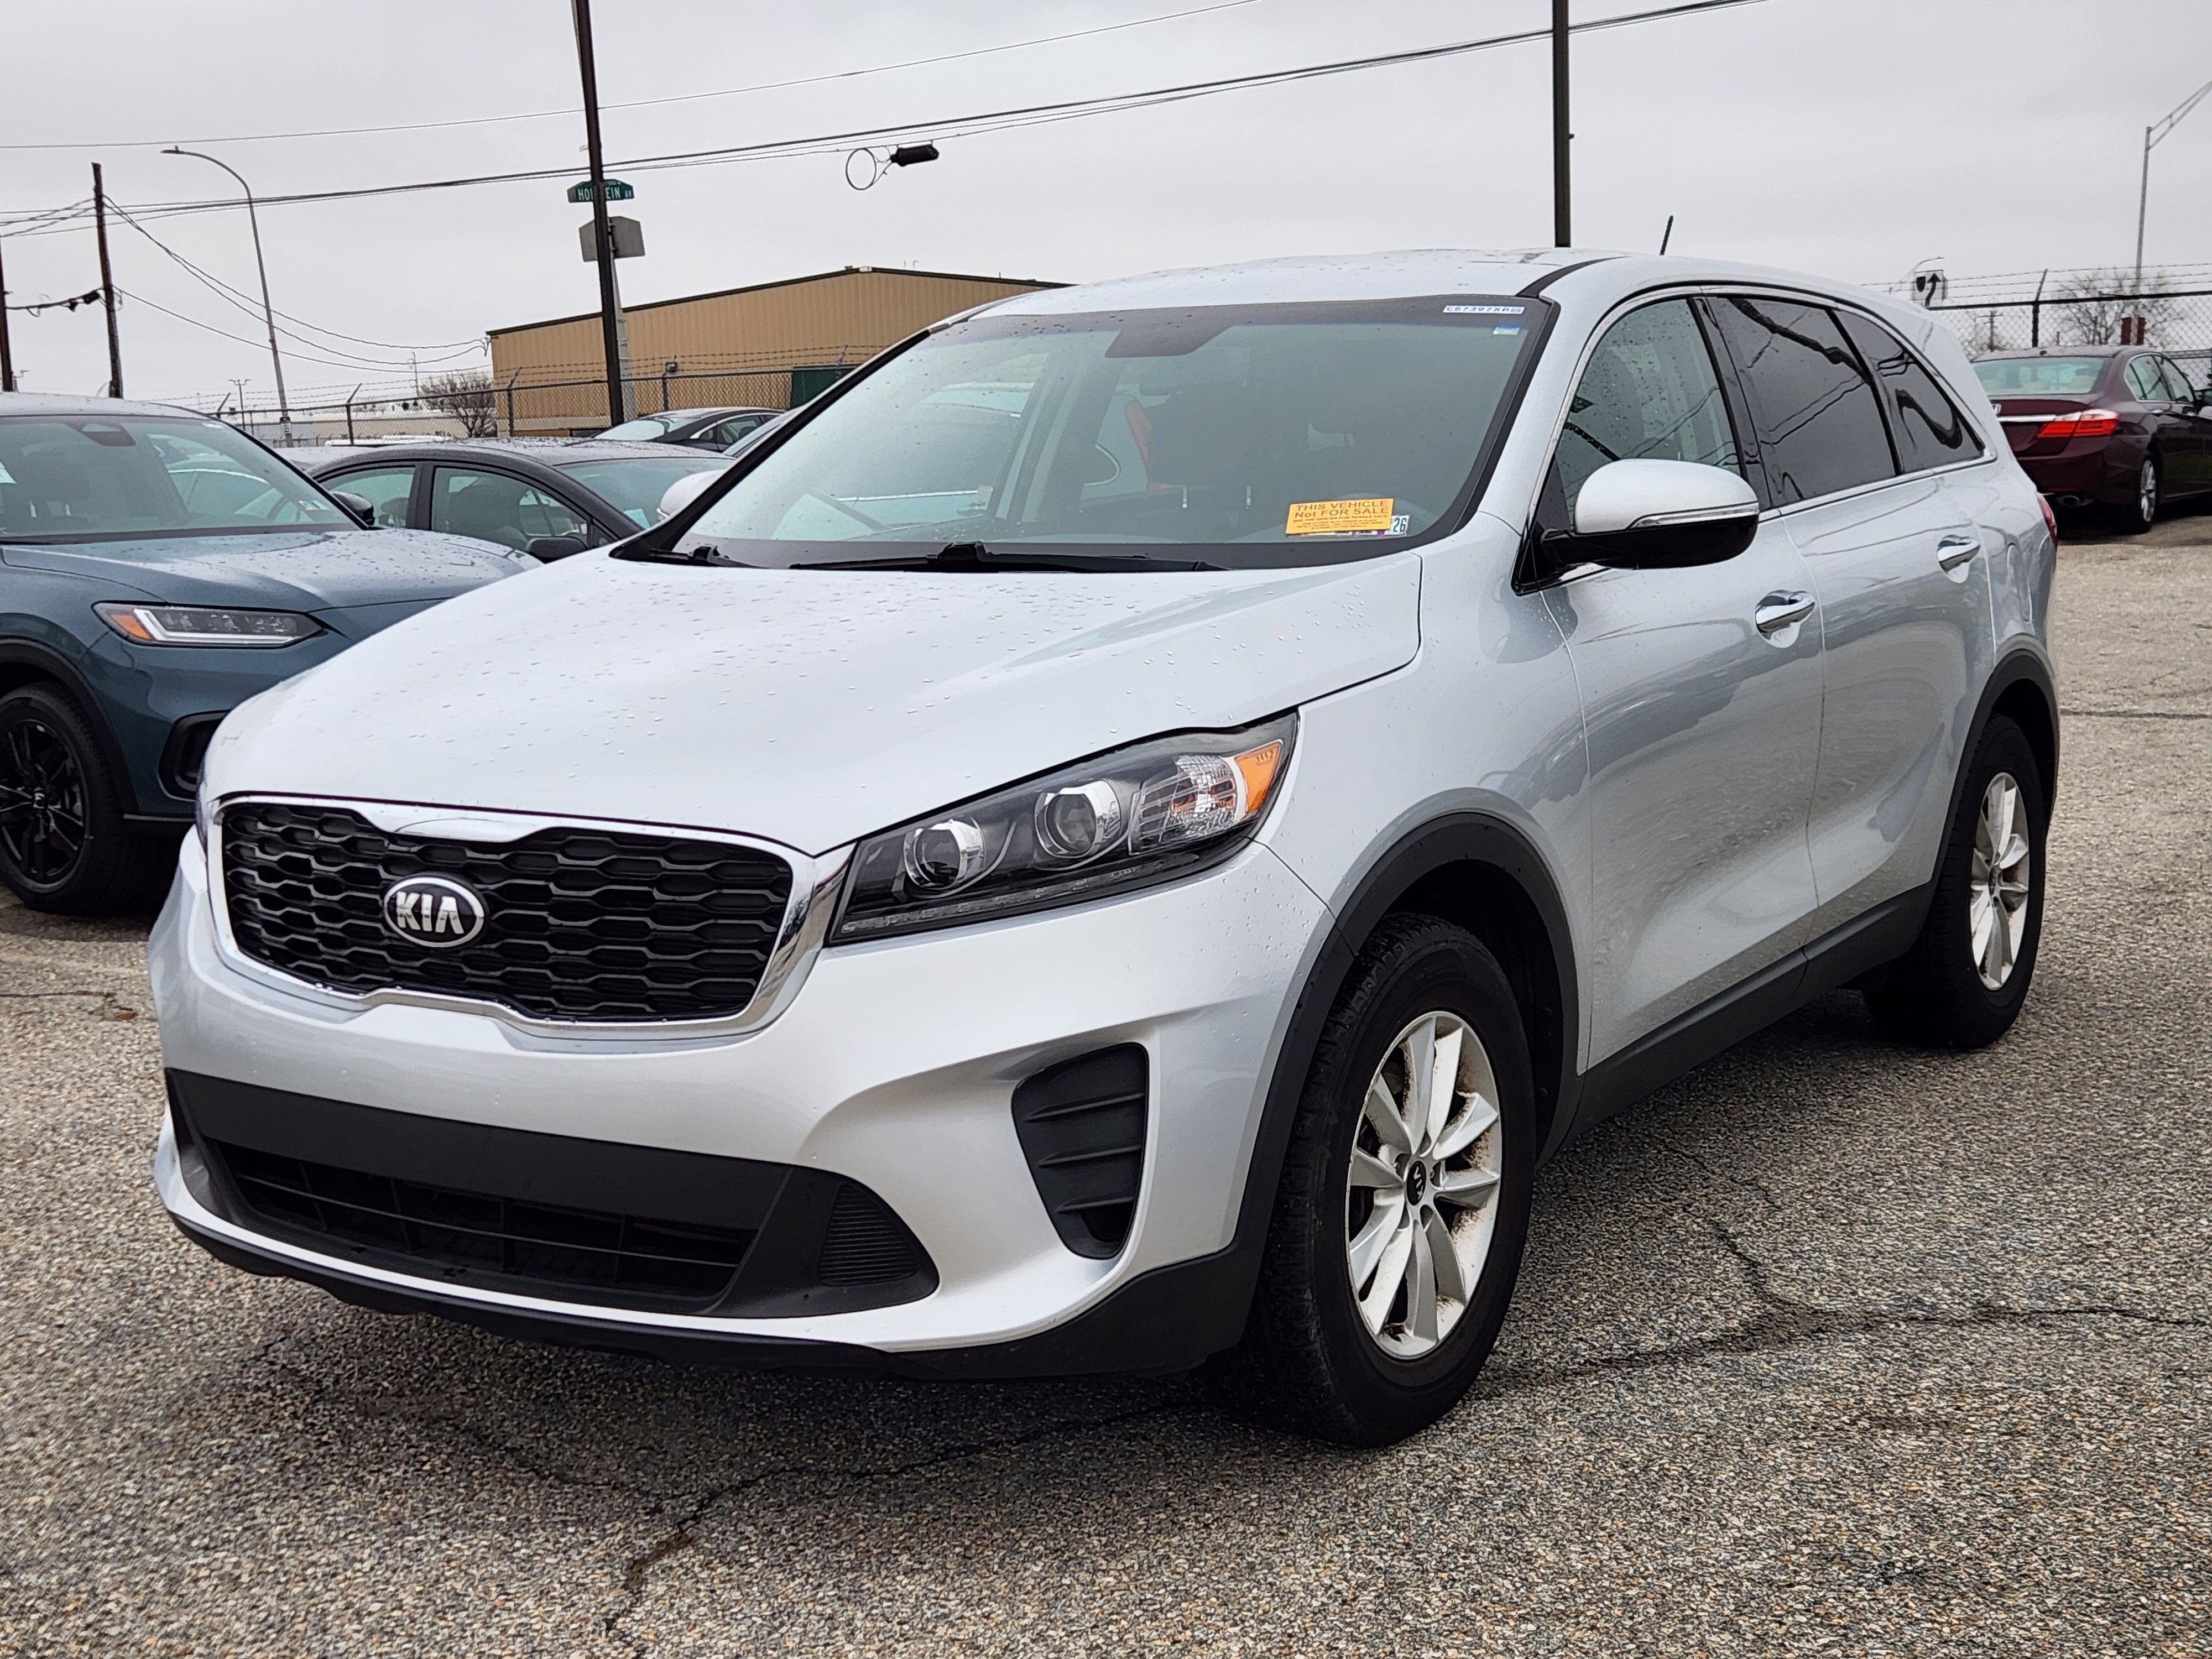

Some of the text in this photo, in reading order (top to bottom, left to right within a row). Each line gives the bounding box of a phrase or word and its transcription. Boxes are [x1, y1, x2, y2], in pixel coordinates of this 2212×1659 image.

[577, 187, 621, 200] HOEIN
[1331, 501, 1387, 509] VEHICLE
[1392, 517, 1406, 533] 26
[396, 891, 465, 935] KIA
